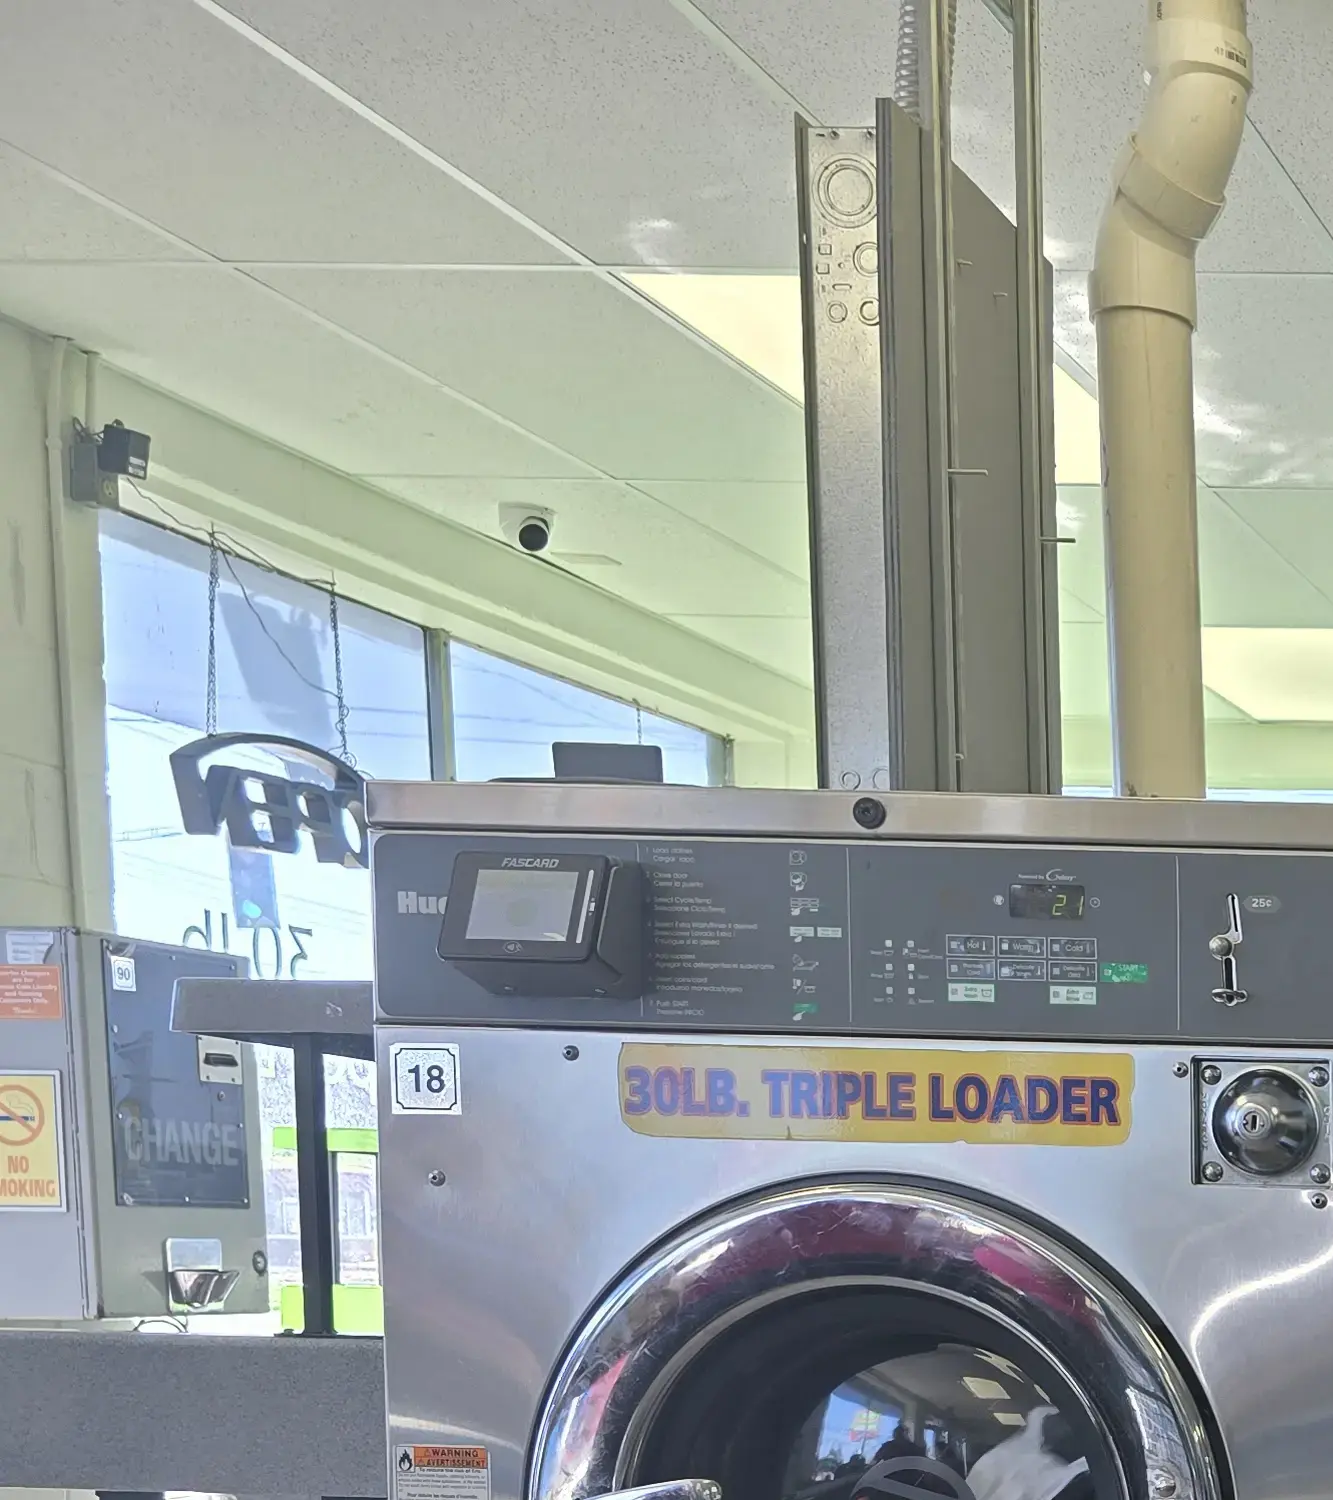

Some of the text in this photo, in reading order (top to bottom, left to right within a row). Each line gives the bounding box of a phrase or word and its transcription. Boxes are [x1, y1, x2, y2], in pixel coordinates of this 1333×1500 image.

[501, 857, 560, 869] FASCARD
[1051, 894, 1085, 917] 21
[1251, 898, 1272, 908] 25¢
[117, 967, 131, 981] 90
[406, 1064, 446, 1094] 18
[624, 1066, 1122, 1126] 30LB. TRIPLE LOADER
[124, 1119, 239, 1166] CHANGE
[8, 1155, 29, 1174] NO
[432, 1449, 479, 1458] WARNING
